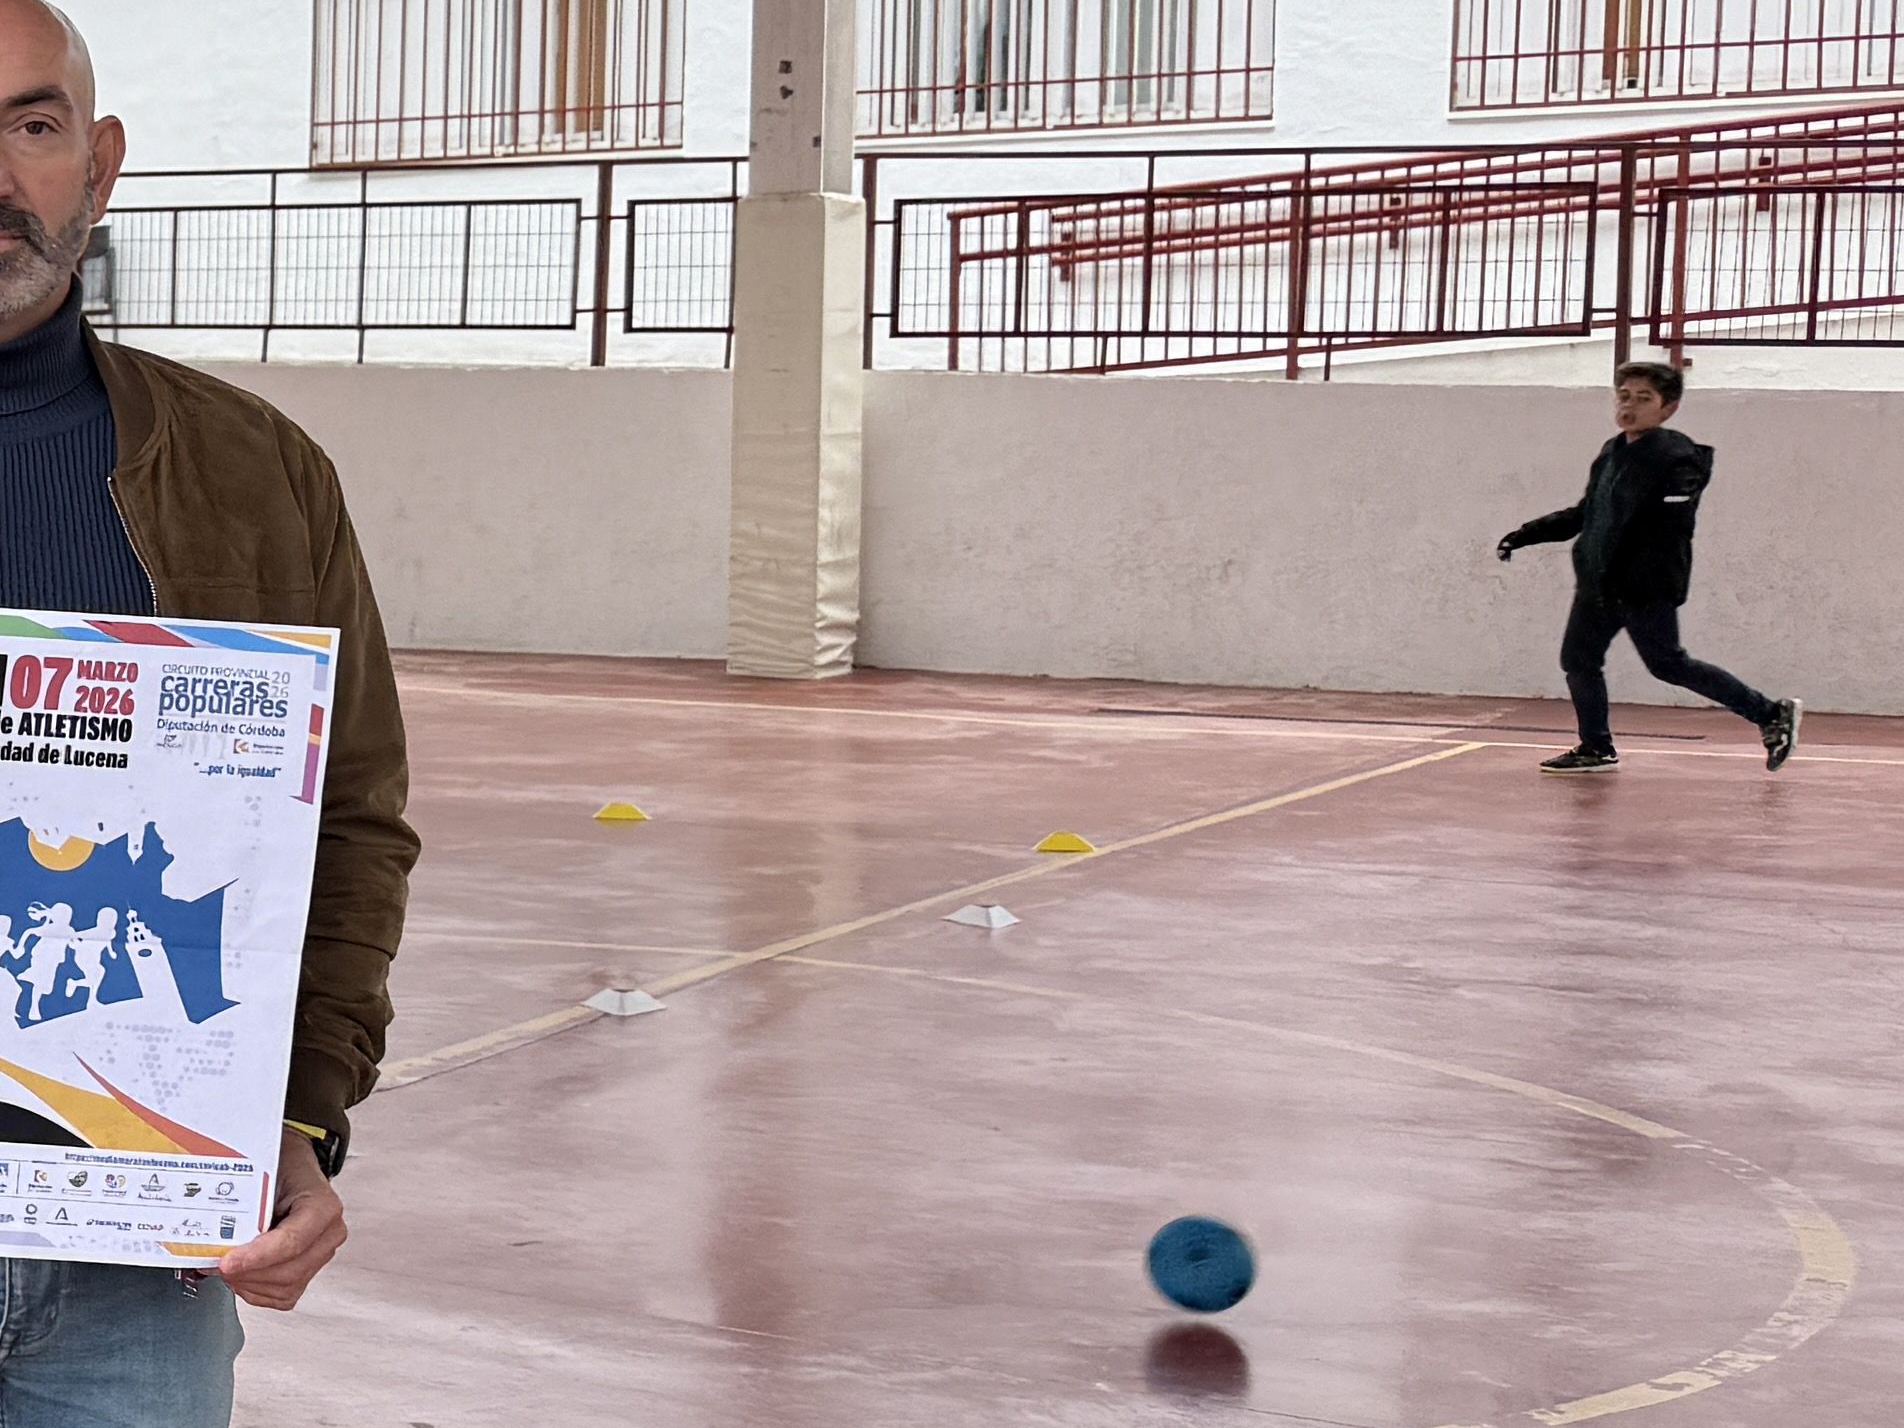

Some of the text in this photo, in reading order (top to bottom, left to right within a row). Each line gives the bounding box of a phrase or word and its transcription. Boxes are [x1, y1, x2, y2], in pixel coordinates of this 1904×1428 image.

[10, 654, 74, 710] 07
[77, 659, 139, 683] MARZO
[162, 663, 208, 676] CIRCUITO
[271, 671, 291, 685] 20
[161, 675, 270, 699] carreras
[74, 685, 135, 716] 2026
[158, 690, 289, 719] populares
[18, 712, 133, 743] ATLETISMO
[238, 723, 286, 738] Córdoba
[37, 742, 60, 765] de
[63, 745, 128, 769] Lucena
